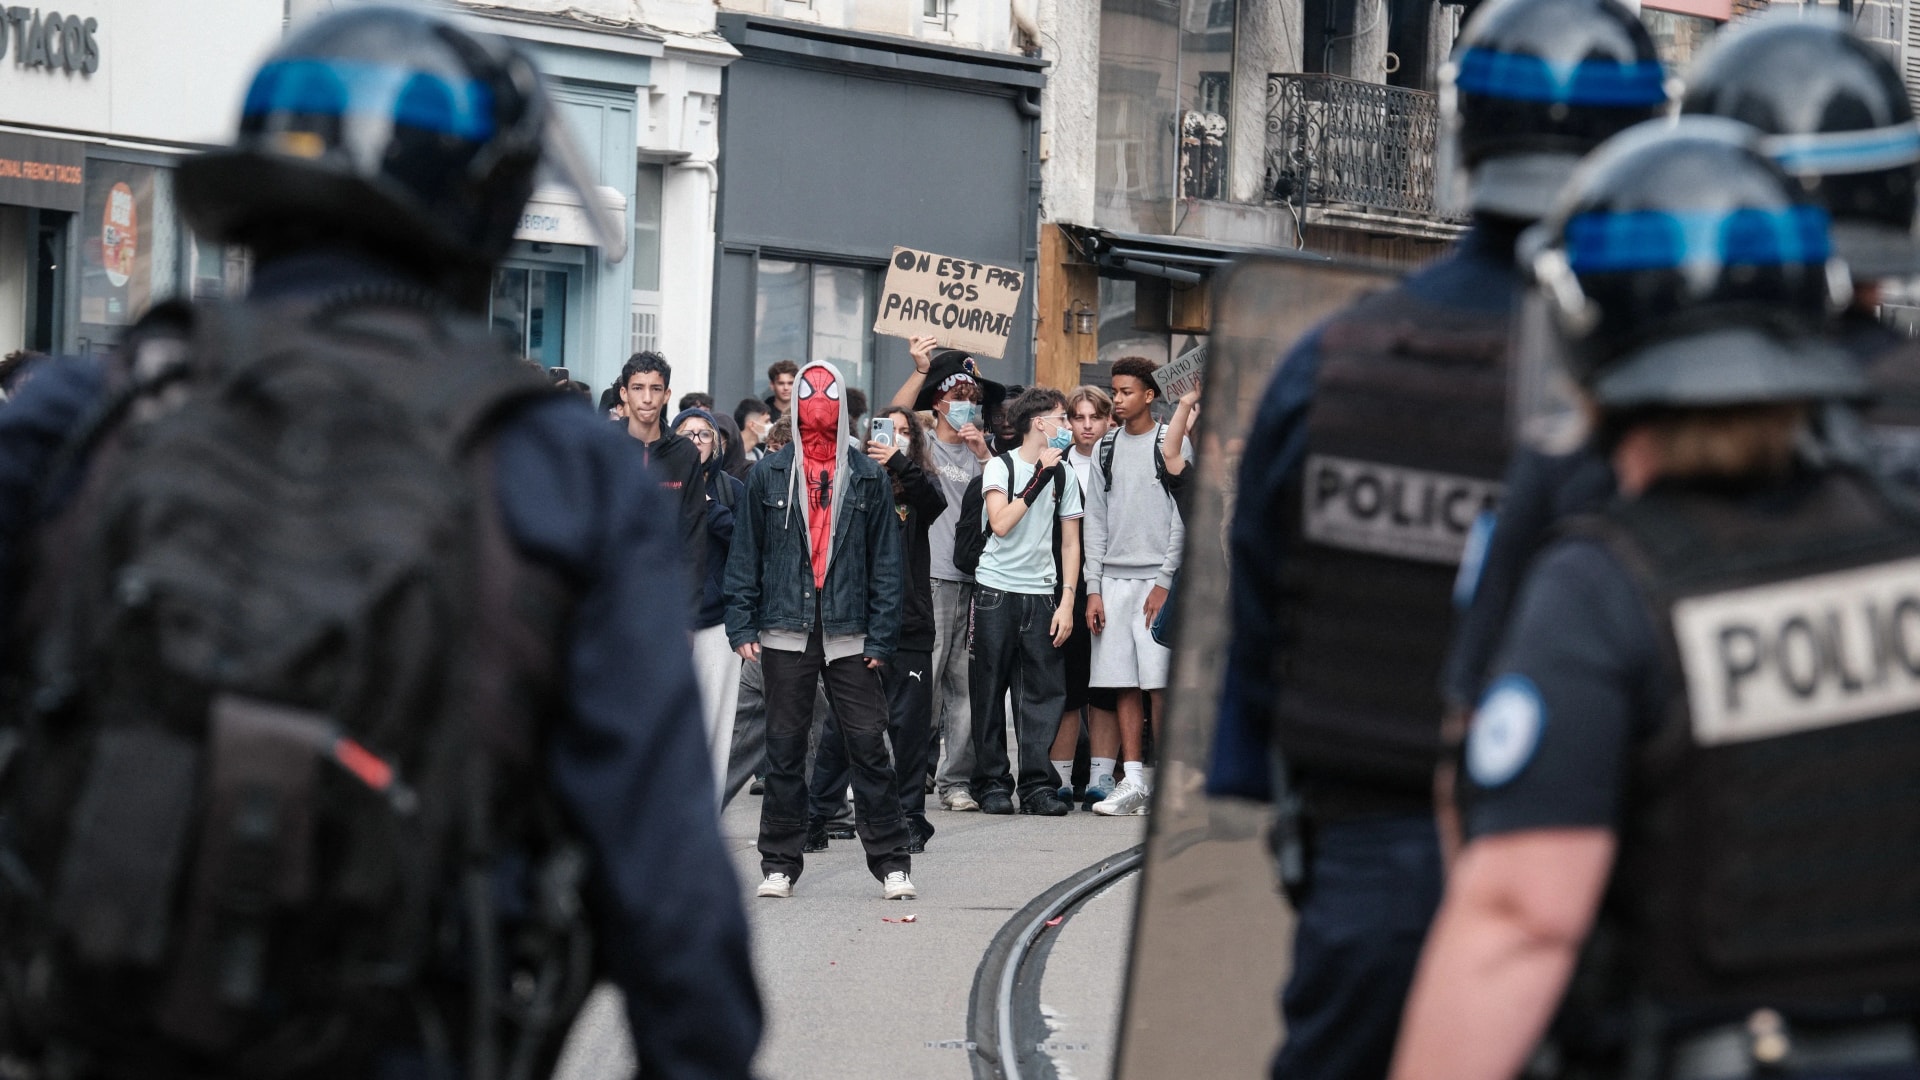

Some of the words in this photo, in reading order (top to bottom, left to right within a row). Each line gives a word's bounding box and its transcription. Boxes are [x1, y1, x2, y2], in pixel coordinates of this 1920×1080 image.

[23, 161, 55, 181] FRENCH
[56, 164, 82, 185] TACOS
[894, 250, 930, 273] ON
[936, 257, 983, 280] EST
[985, 267, 1021, 292] PAS
[938, 280, 979, 301] VOS
[1157, 359, 1191, 384] SIAMO
[1315, 466, 1496, 535] POLIC
